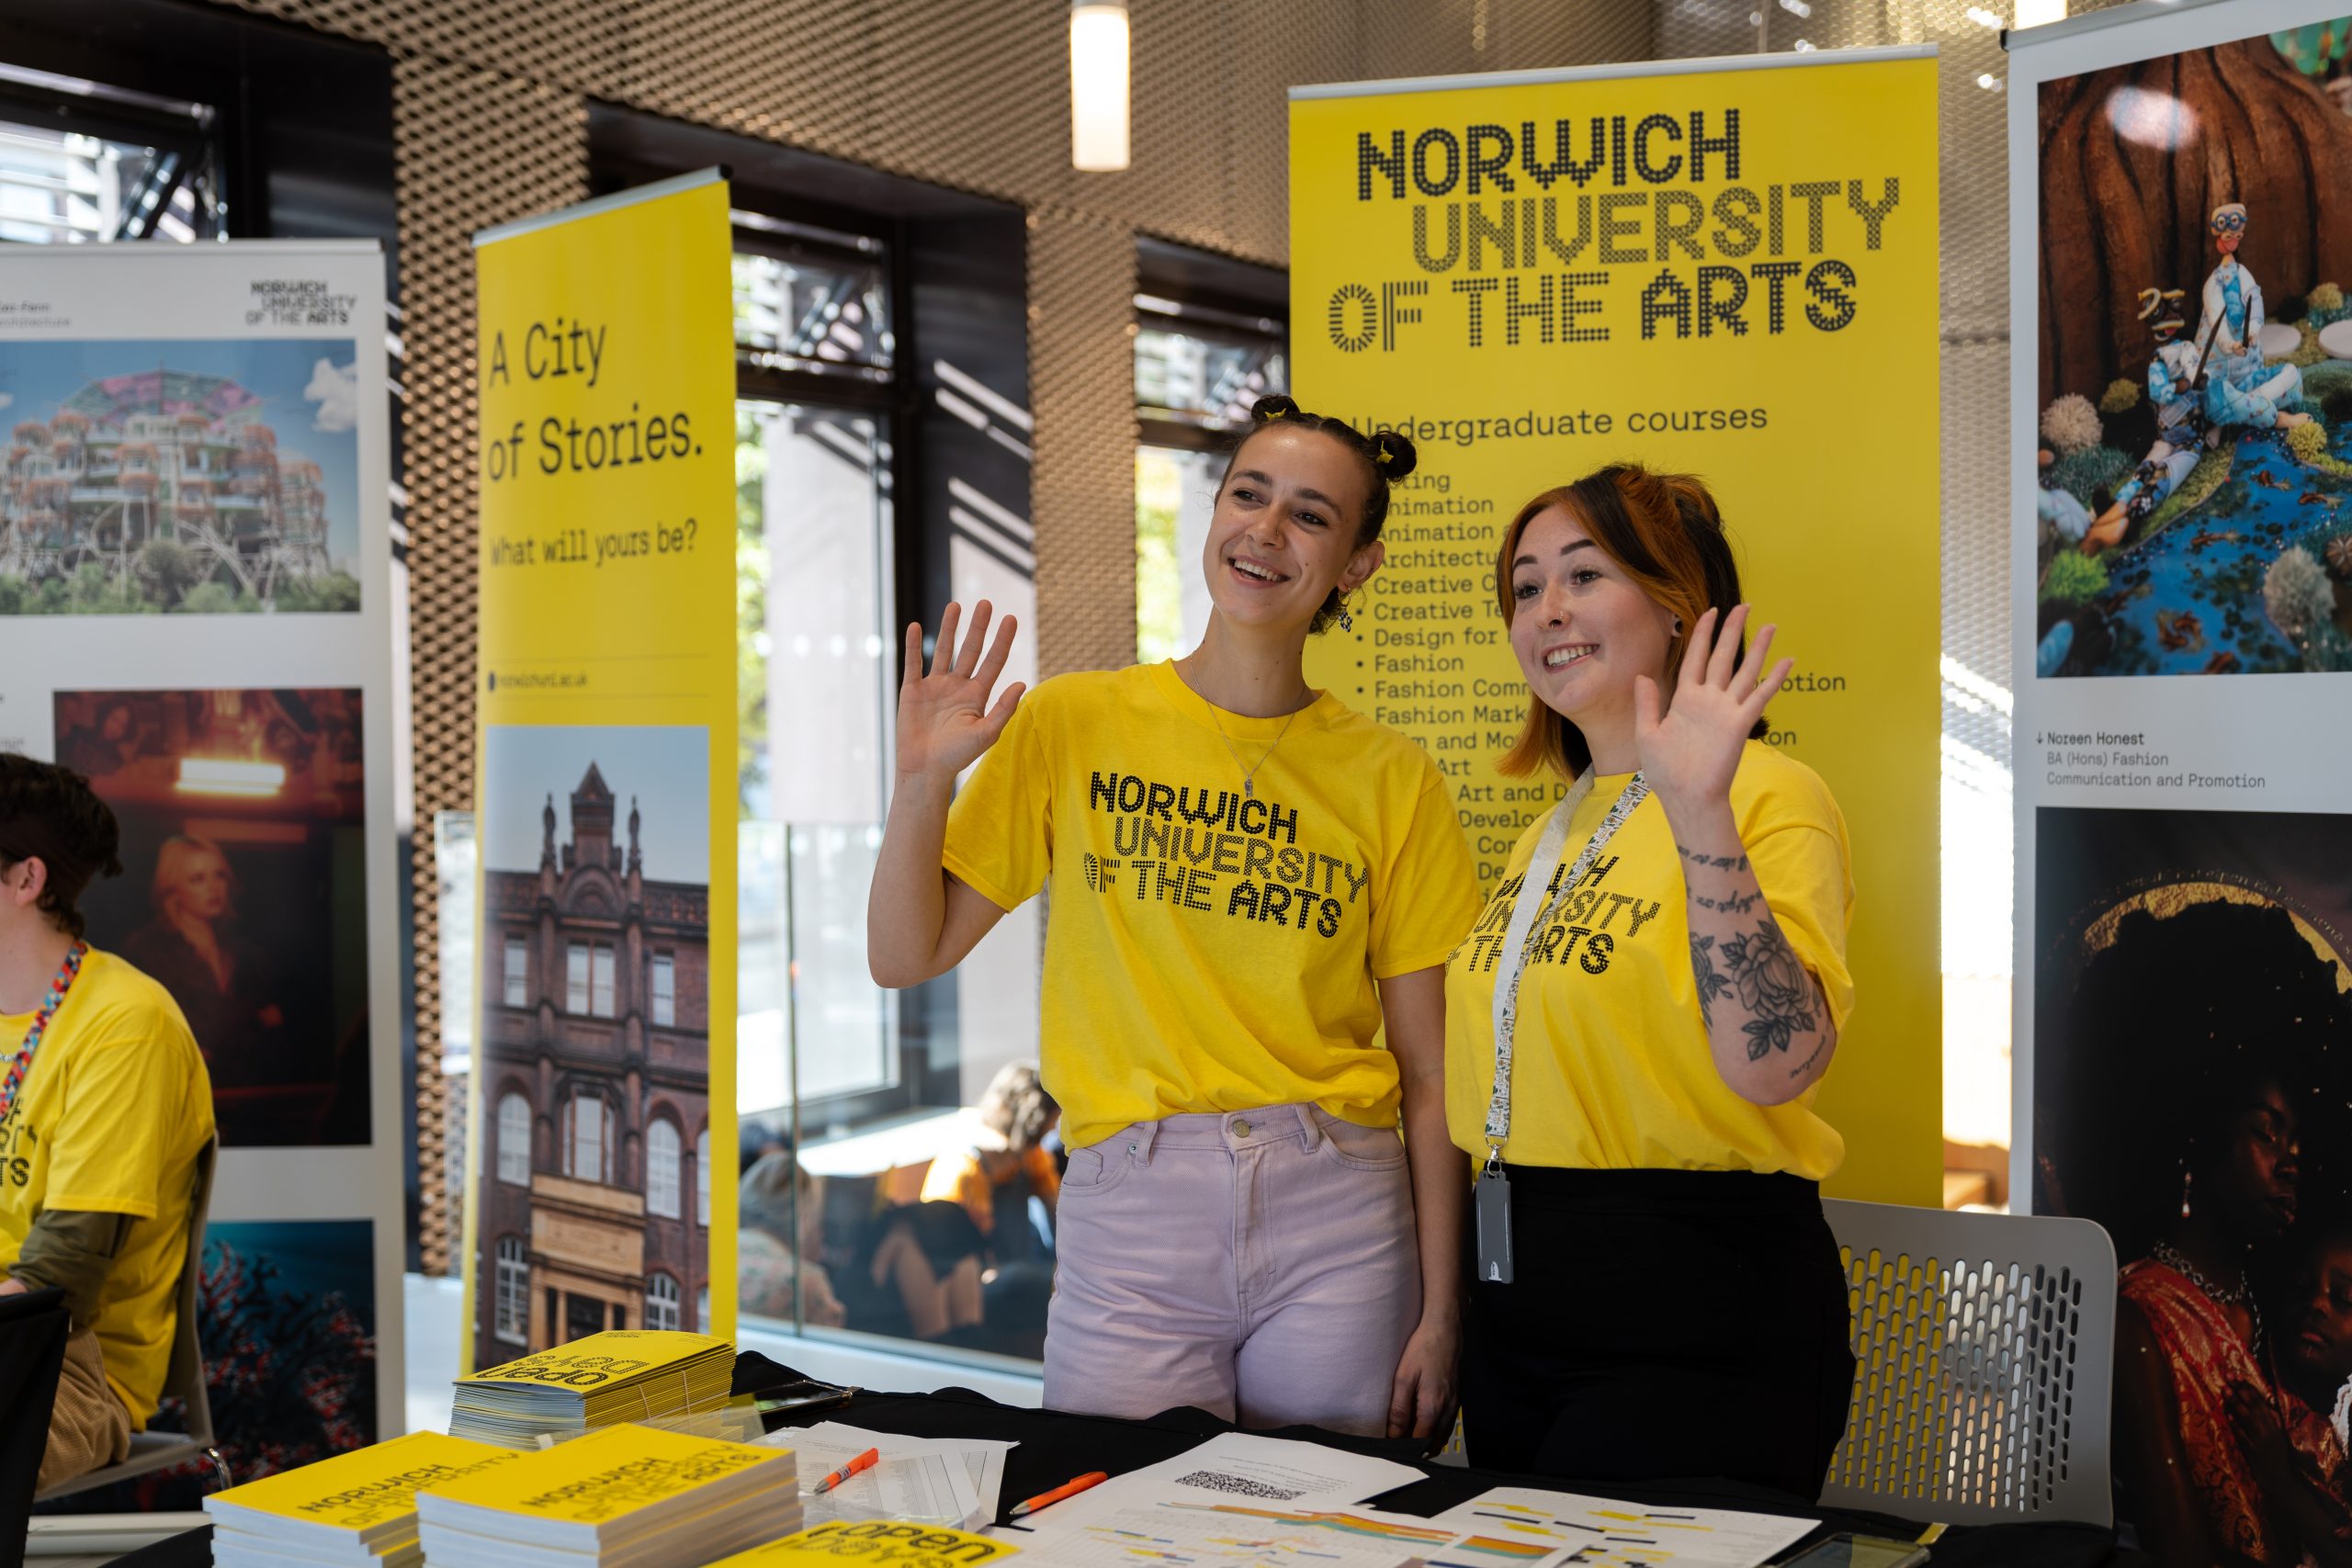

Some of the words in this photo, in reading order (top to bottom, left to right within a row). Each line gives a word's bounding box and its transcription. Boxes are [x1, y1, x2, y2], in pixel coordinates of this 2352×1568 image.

[1357, 108, 1739, 200] NORWICH
[1412, 177, 1900, 274] UNIVERSITY
[250, 281, 328, 296] NORWICH
[261, 294, 356, 310] UNIVERSITY
[1329, 280, 1428, 353] OF
[1452, 271, 1610, 348] THE
[1641, 259, 1856, 340] ARTS
[245, 310, 265, 325] OF
[271, 309, 301, 325] THE
[306, 309, 349, 325] ARTS
[489, 330, 510, 389] A
[525, 317, 606, 388] City
[1627, 408, 1769, 436] courses
[487, 420, 525, 482] of
[538, 401, 703, 475] Stories.
[1388, 496, 1494, 515] nimation
[490, 535, 537, 567] What
[543, 527, 589, 562] will
[595, 529, 650, 569] yours
[657, 517, 698, 553] be?
[1374, 575, 1473, 595] Creative
[1374, 602, 1474, 621] Creative
[1374, 628, 1454, 649] Design
[1464, 626, 1498, 645] for
[1375, 654, 1464, 672] Fashion
[1375, 681, 1464, 698] Fashion
[1375, 706, 1464, 724] Fashion
[1474, 705, 1526, 723] Mark
[1436, 732, 1476, 750] and
[2047, 732, 2092, 745] Noreen
[2096, 731, 2144, 746] Honest
[2047, 751, 2063, 765] BA
[2066, 751, 2109, 767] (Hons)
[2112, 751, 2169, 766] Fashion
[2047, 772, 2151, 786] Communication
[2156, 773, 2183, 787] and
[2188, 773, 2266, 788] Promotion
[1457, 784, 1495, 802] Art
[1503, 784, 1544, 802] and
[1091, 772, 1297, 844] NORWICH
[1114, 816, 1368, 904] UNIVERSITY
[1131, 860, 1216, 911] THE
[1227, 879, 1342, 938] ARTS
[681, 1454, 762, 1482] ARTS
[297, 1464, 454, 1514] NORWICH
[344, 1452, 520, 1511] UNIVERSITY
[519, 1457, 671, 1508] NORWICH
[339, 1509, 383, 1527] OF
